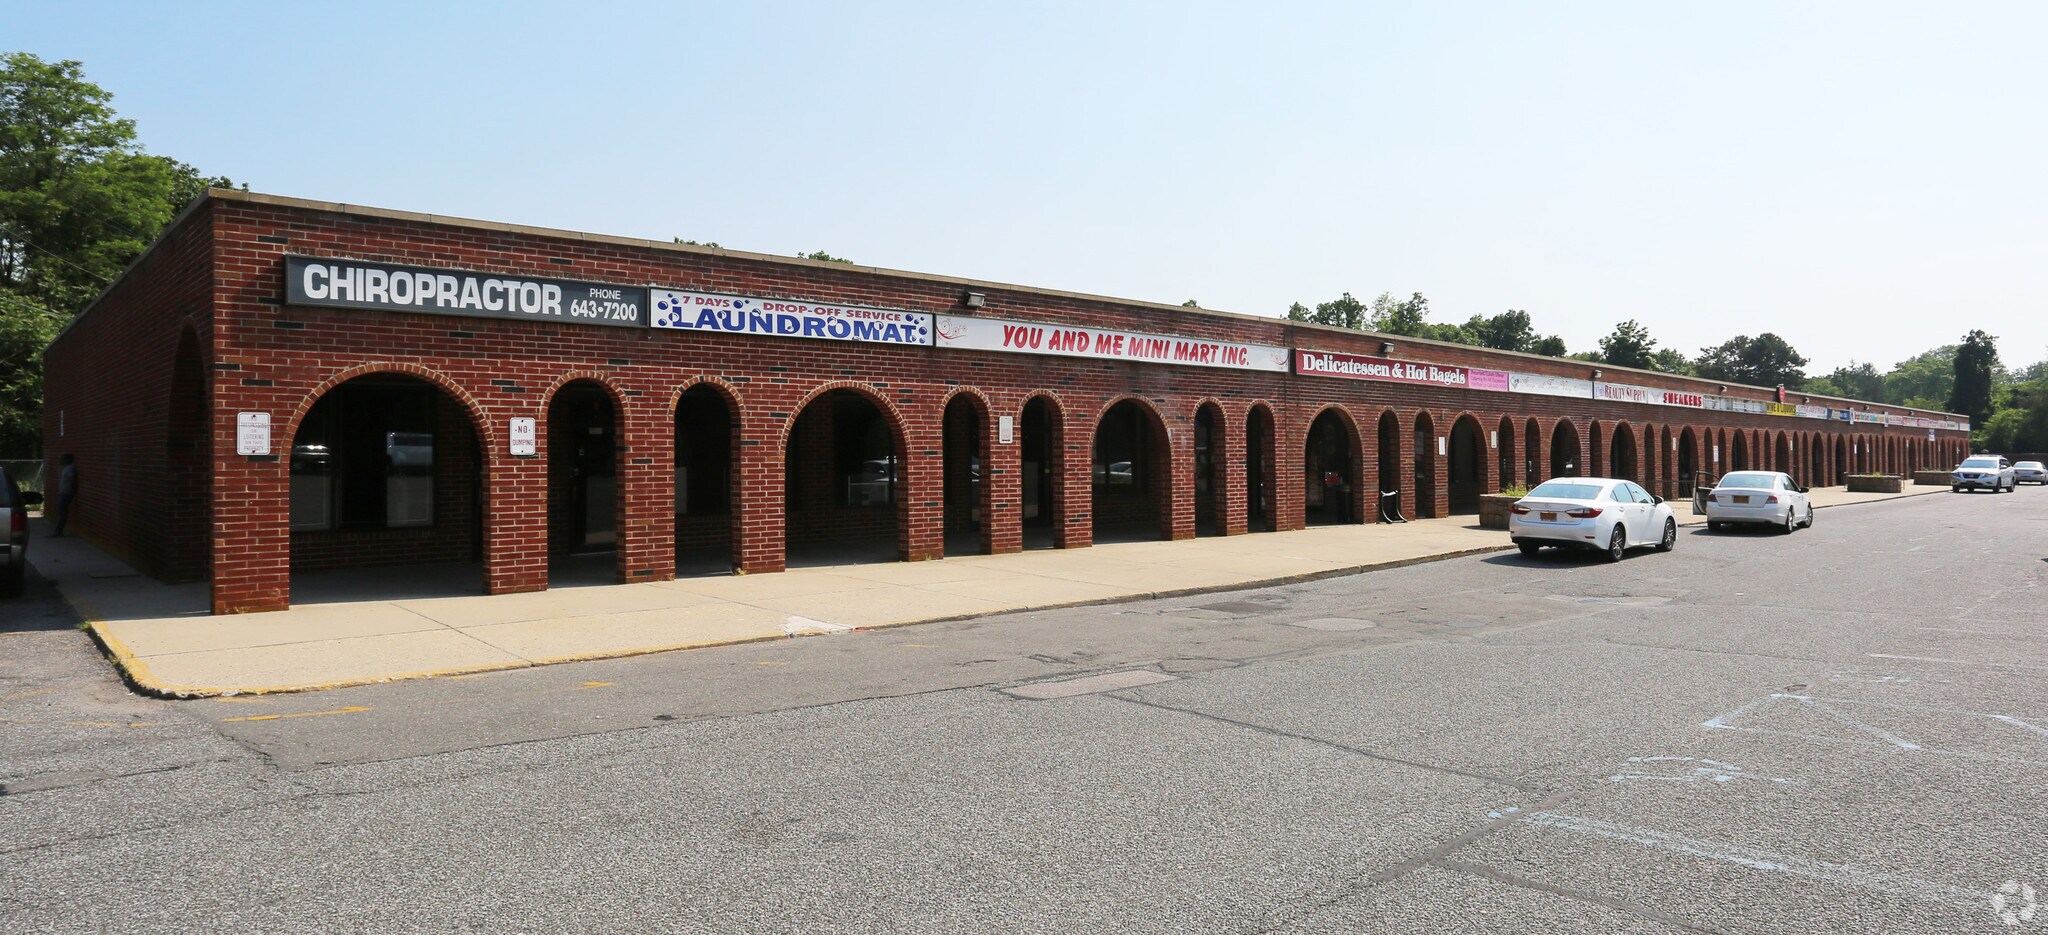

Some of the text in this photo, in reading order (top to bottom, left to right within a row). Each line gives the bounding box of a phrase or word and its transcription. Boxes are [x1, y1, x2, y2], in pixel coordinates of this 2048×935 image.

[303, 264, 562, 315] CHIROPRACTOR
[589, 288, 621, 300] PHONE
[682, 296, 730, 308] 7 DAYS
[762, 302, 901, 322] DROP-OFF SERVICE
[672, 306, 917, 343] LAUNDROMAT
[1002, 325, 1250, 366] YOU AND ME MINI MART INC.
[1302, 354, 1390, 378] Delicatessen
[1391, 363, 1404, 379] &
[1405, 364, 1428, 380] Hot
[1429, 366, 1466, 385] Bagels
[1604, 385, 1625, 400] BEAUTY
[1663, 392, 1702, 407] SNEAKERS
